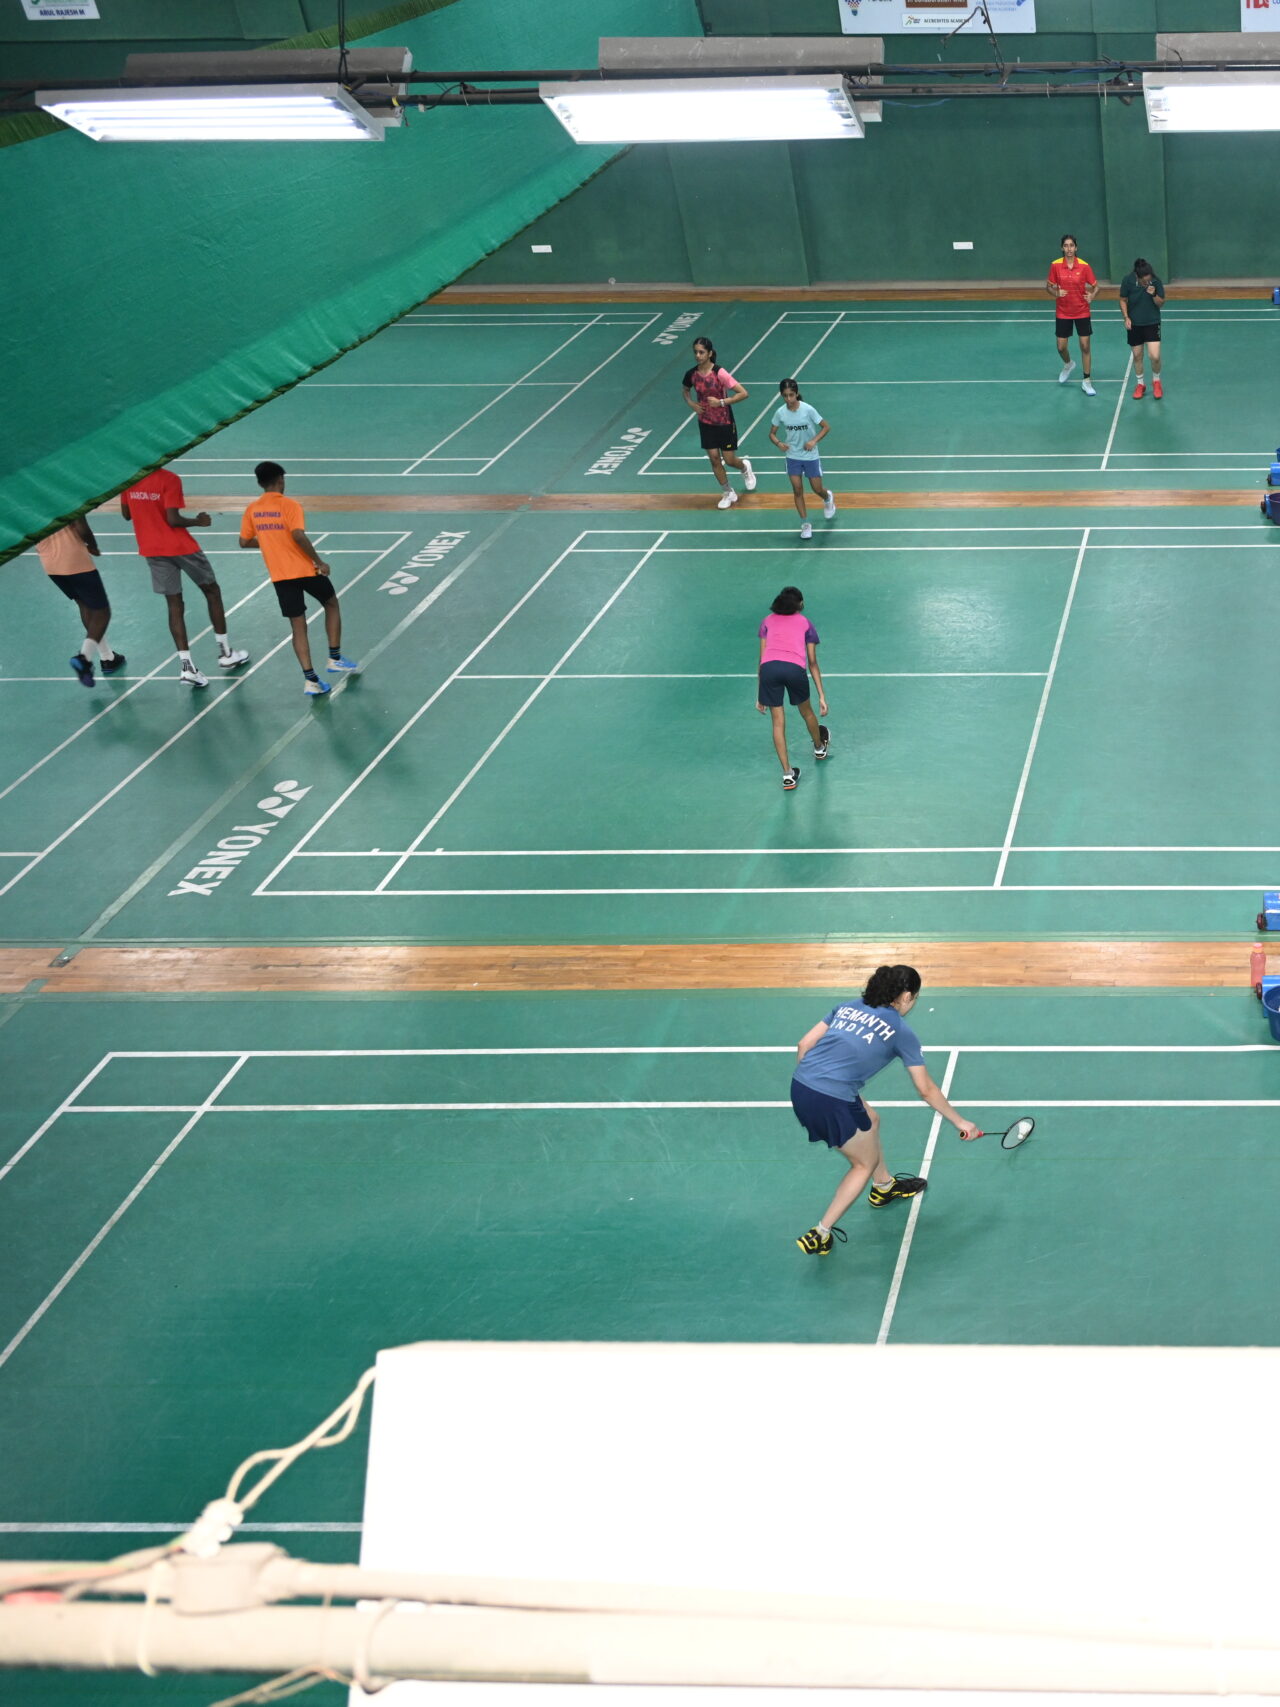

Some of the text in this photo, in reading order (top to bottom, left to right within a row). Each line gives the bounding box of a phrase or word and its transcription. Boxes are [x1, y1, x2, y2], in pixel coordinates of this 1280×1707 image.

[663, 312, 704, 332] YONEX
[584, 444, 639, 475] YONEX
[401, 531, 471, 570] YONEX
[167, 821, 279, 896] YONEX
[830, 1019, 875, 1044] INDIA
[836, 1006, 896, 1042] HEMANTH
